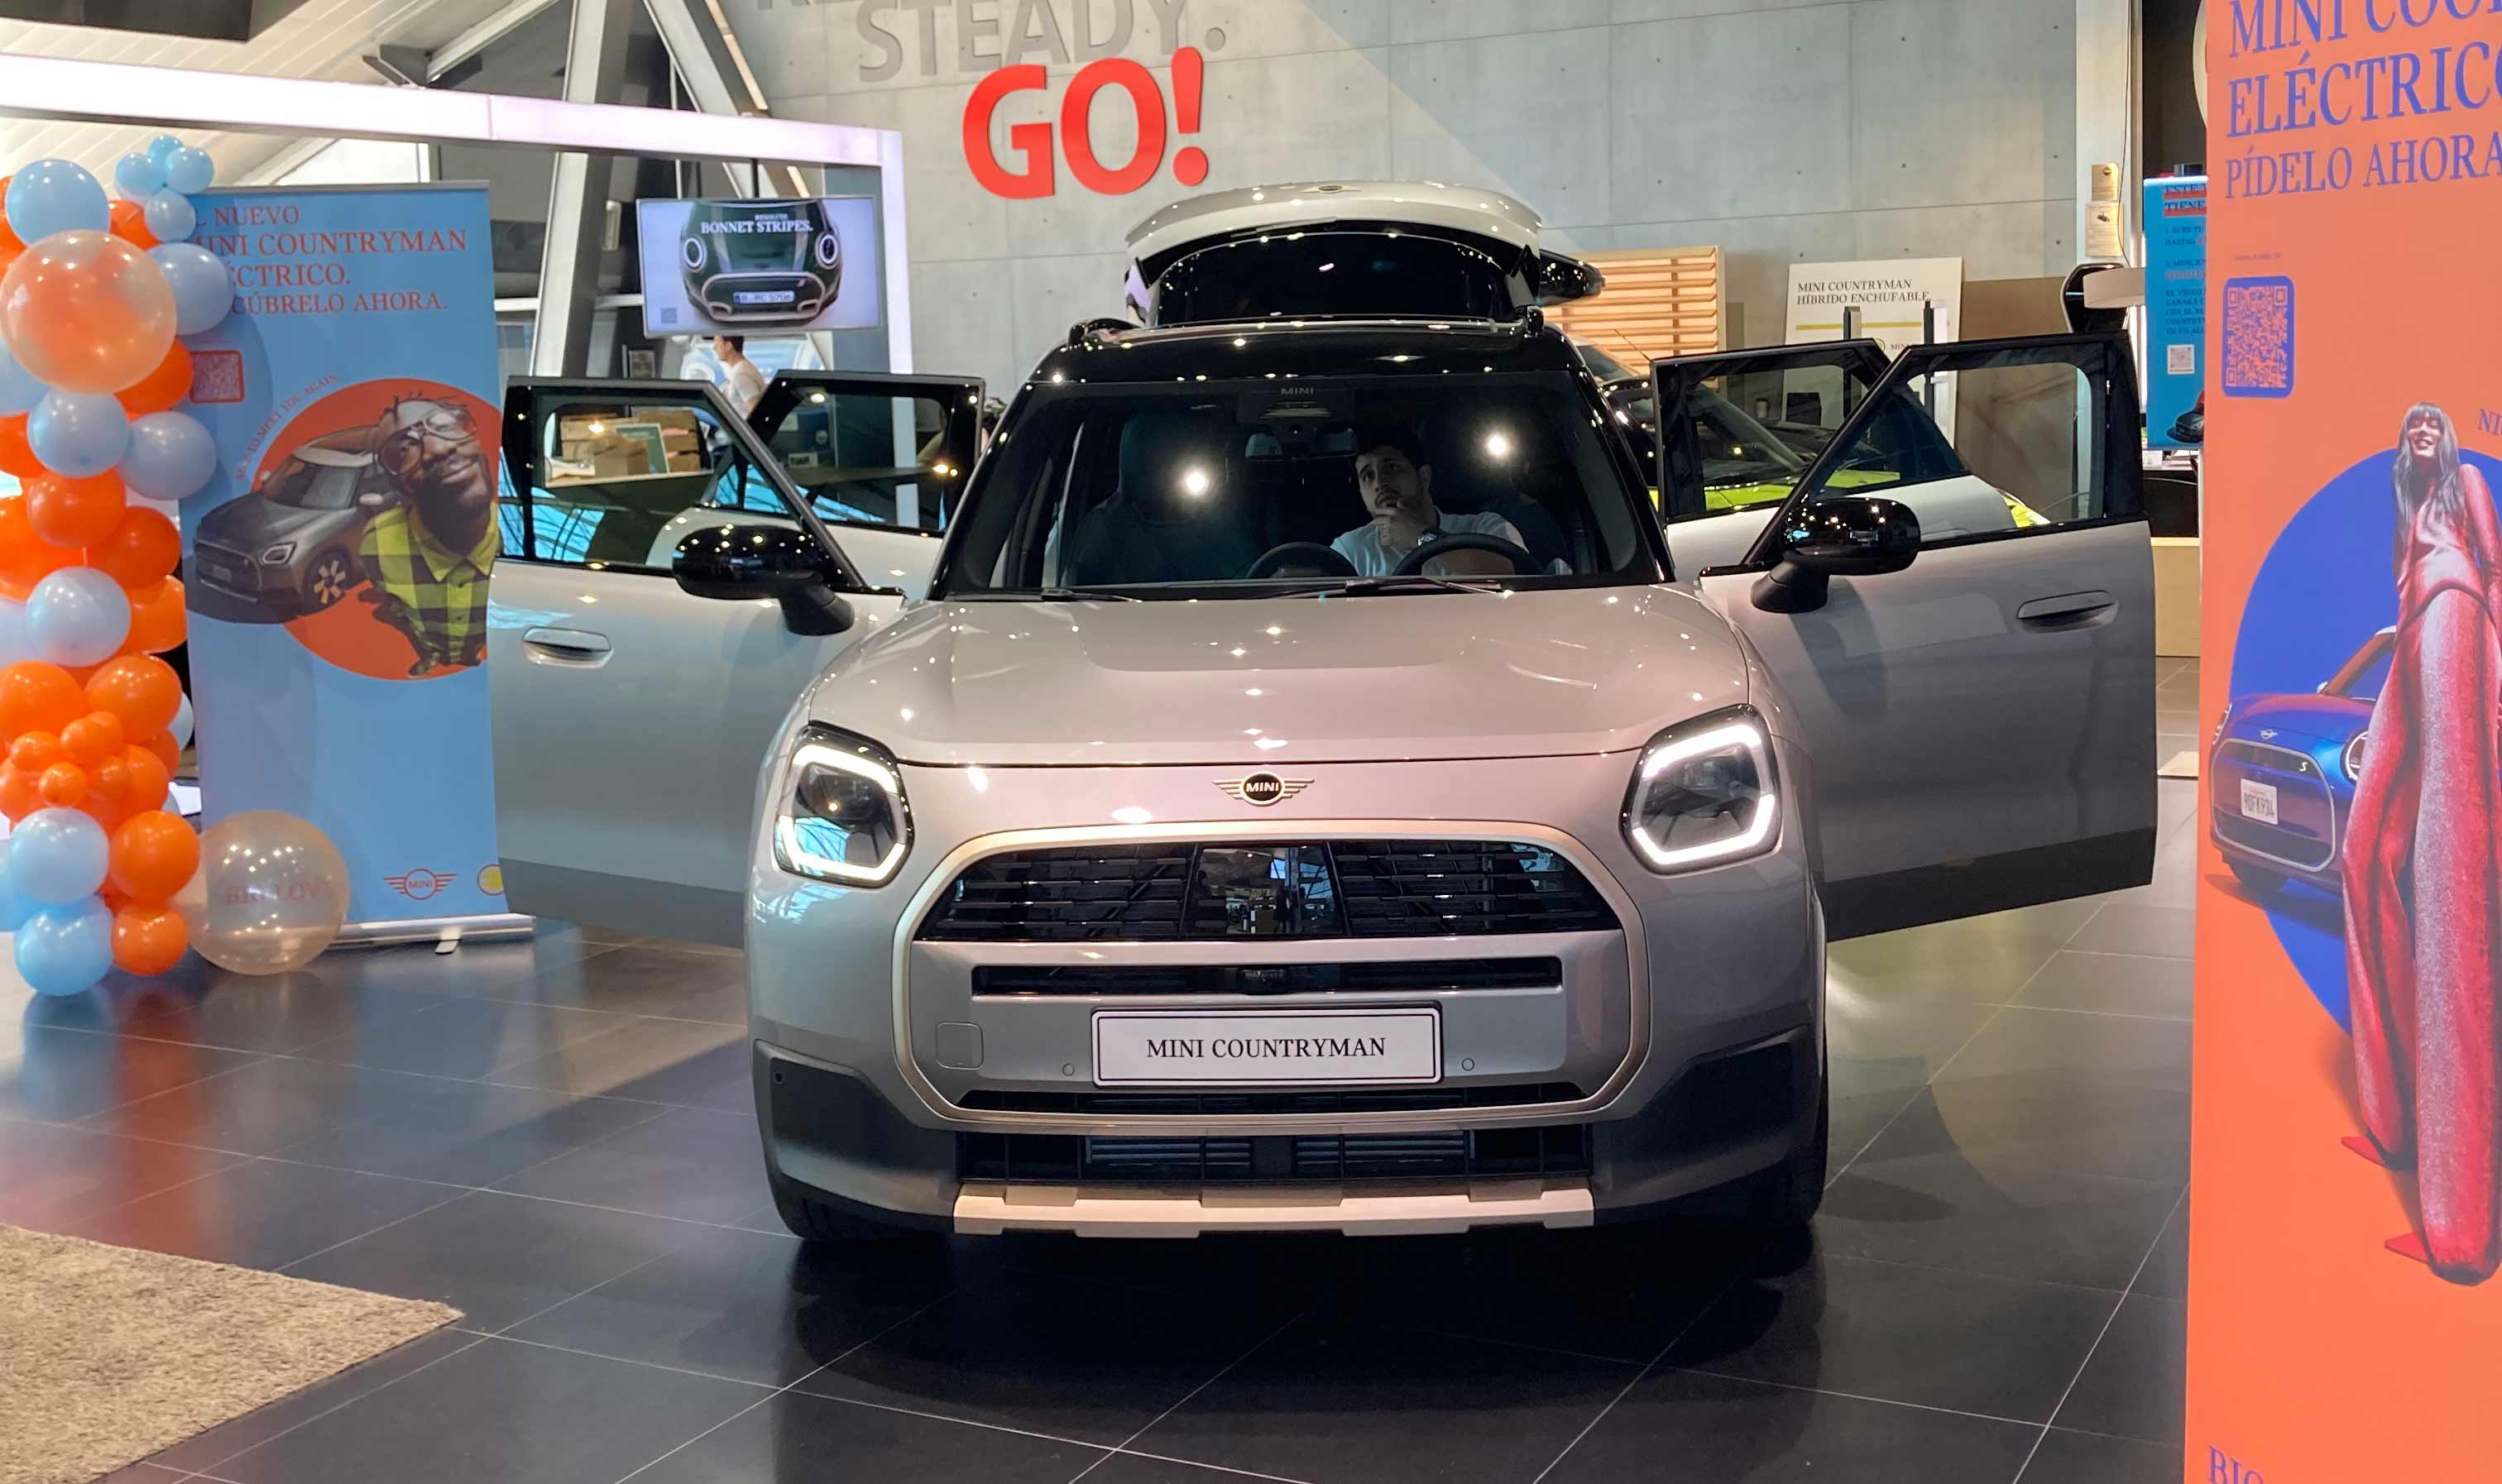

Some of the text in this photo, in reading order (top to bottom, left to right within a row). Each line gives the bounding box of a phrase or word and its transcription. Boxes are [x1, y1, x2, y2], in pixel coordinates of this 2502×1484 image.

[2229, 0, 2348, 57] MINI
[962, 45, 1209, 199] GO!
[2226, 146, 2352, 199] PÍDELO
[213, 206, 300, 227] NUEVO
[701, 219, 814, 234] BONNET STRIPES.
[258, 229, 467, 256] COUNTRYMAN
[1797, 279, 1912, 293] MINI COUNTRYMAN
[352, 290, 448, 313] AHORA.
[1281, 386, 1314, 395] MINI
[1245, 782, 1280, 793] MINI
[408, 879, 433, 889] MINI
[1147, 1037, 1386, 1058] MINI COUNTRYMAN
